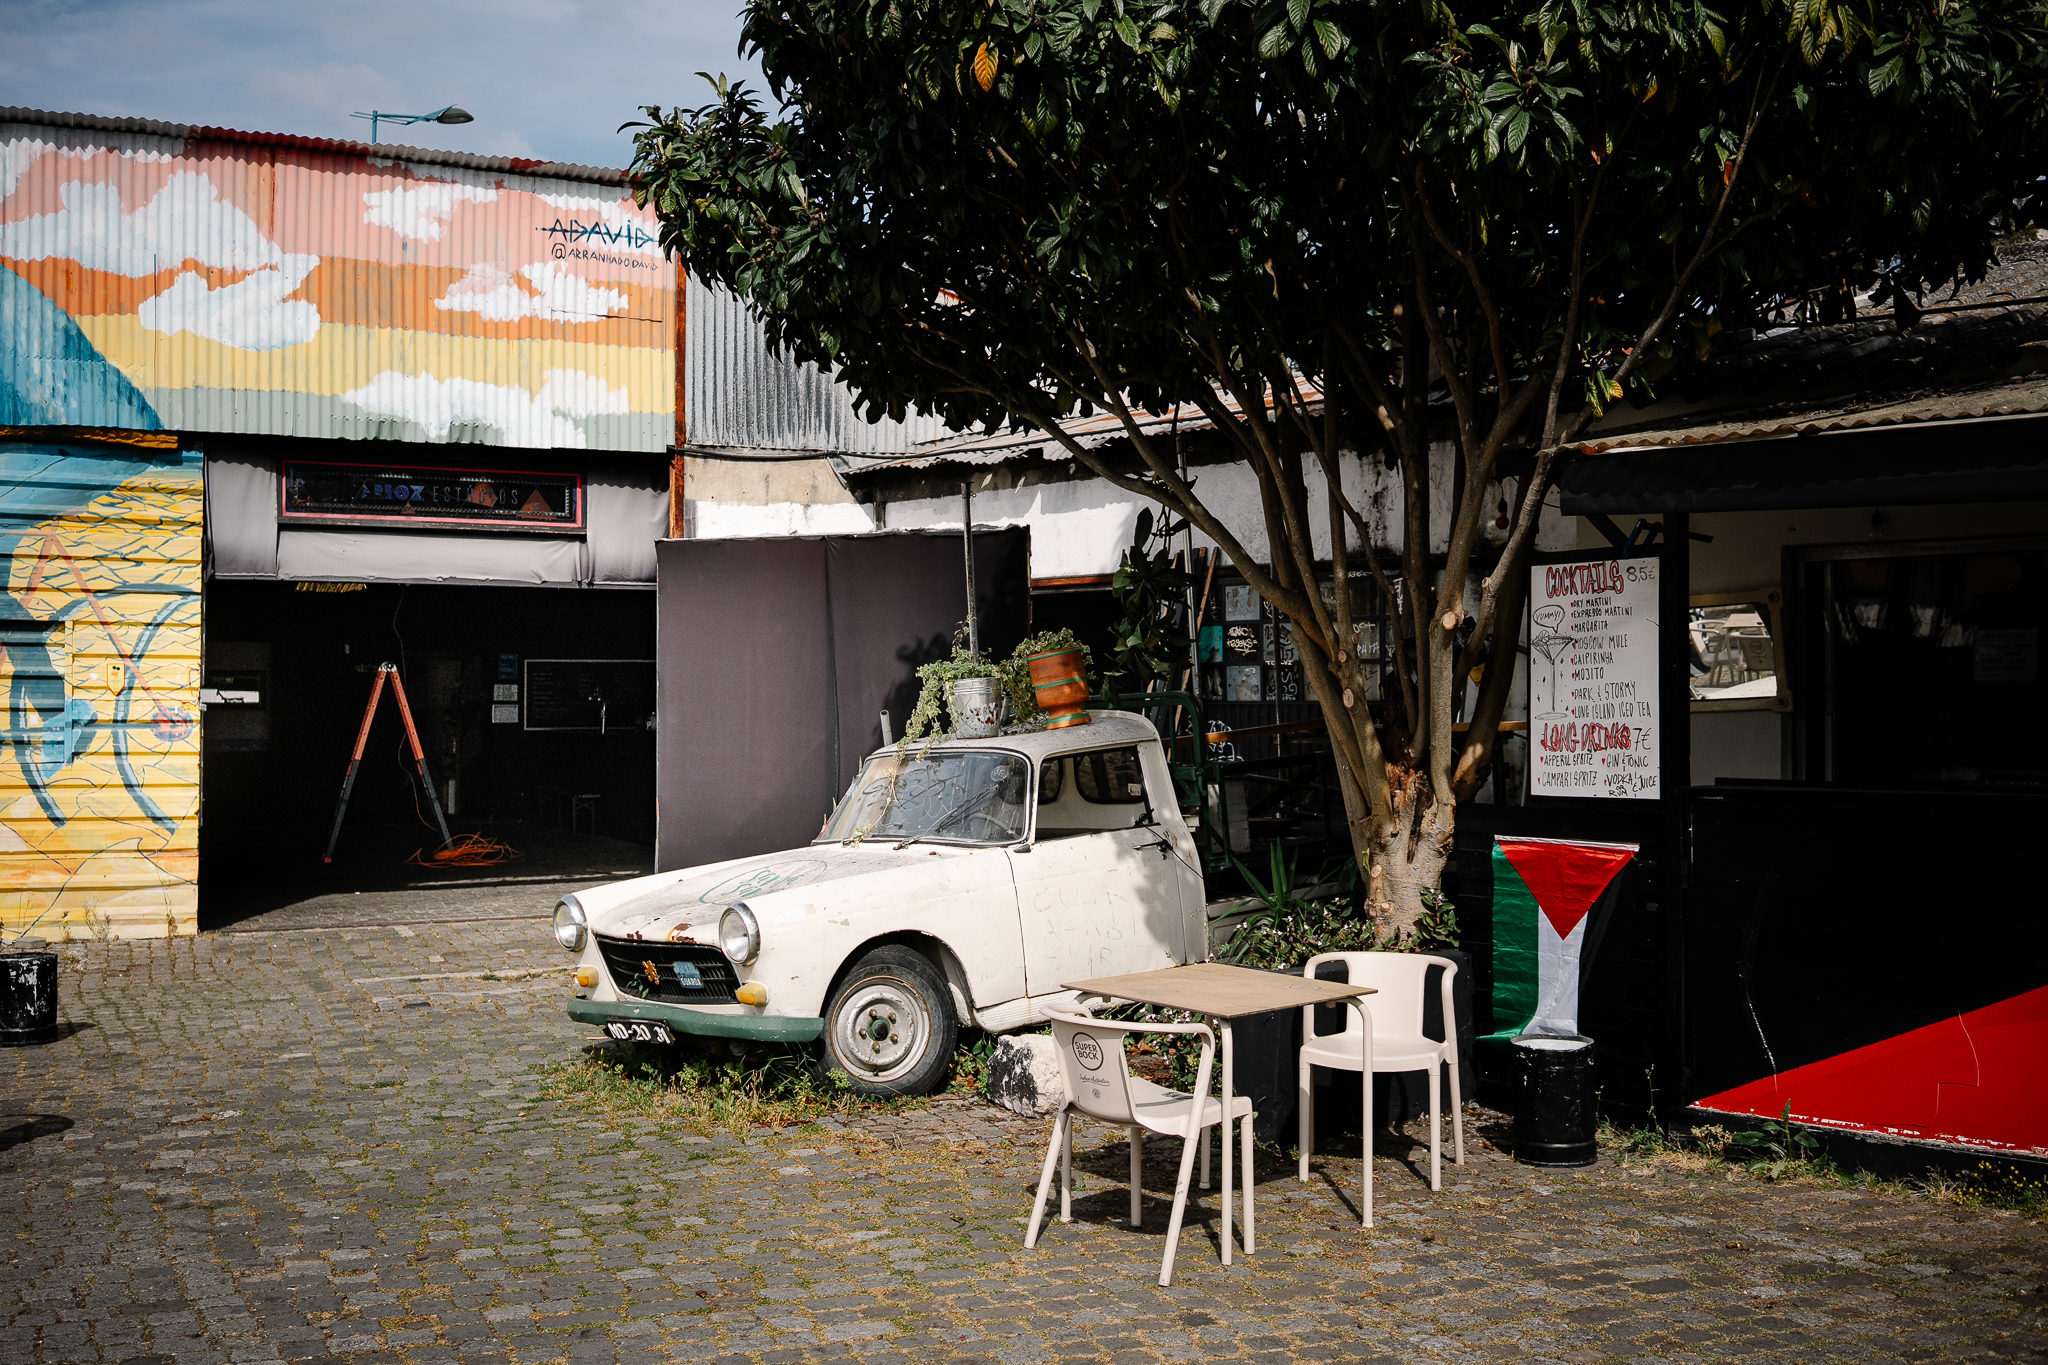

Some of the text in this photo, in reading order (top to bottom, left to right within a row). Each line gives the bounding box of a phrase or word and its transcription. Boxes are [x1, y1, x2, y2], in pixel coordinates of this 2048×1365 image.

[1546, 560, 1656, 599] COCKTAILS 8,5€
[1586, 597, 1612, 608] MARTINI
[1573, 608, 1602, 619] EXPRESSO
[1574, 620, 1608, 633] MARGARITA
[1574, 634, 1629, 650] MOSCOW MULE
[1574, 652, 1615, 665] CAIPIRINHA
[1574, 667, 1605, 681] MOJITO
[1574, 688, 1595, 702] DARK
[1605, 680, 1636, 702] STORMY
[1574, 701, 1652, 720] LONG ISLAND ICED TEA
[1540, 721, 1652, 753] LONG DRINKS 7€
[1572, 753, 1593, 767] SPRITZ
[1606, 753, 1620, 768] GIN
[1625, 754, 1649, 768] TONIC
[1542, 771, 1598, 788] CAMPARI SPRITZ
[1605, 772, 1633, 787] VODKA
[1638, 775, 1658, 791] JUICE
[1608, 789, 1629, 797] RUM
[1074, 1041, 1098, 1053] SUPER
[1077, 1050, 1099, 1061] BOCK
